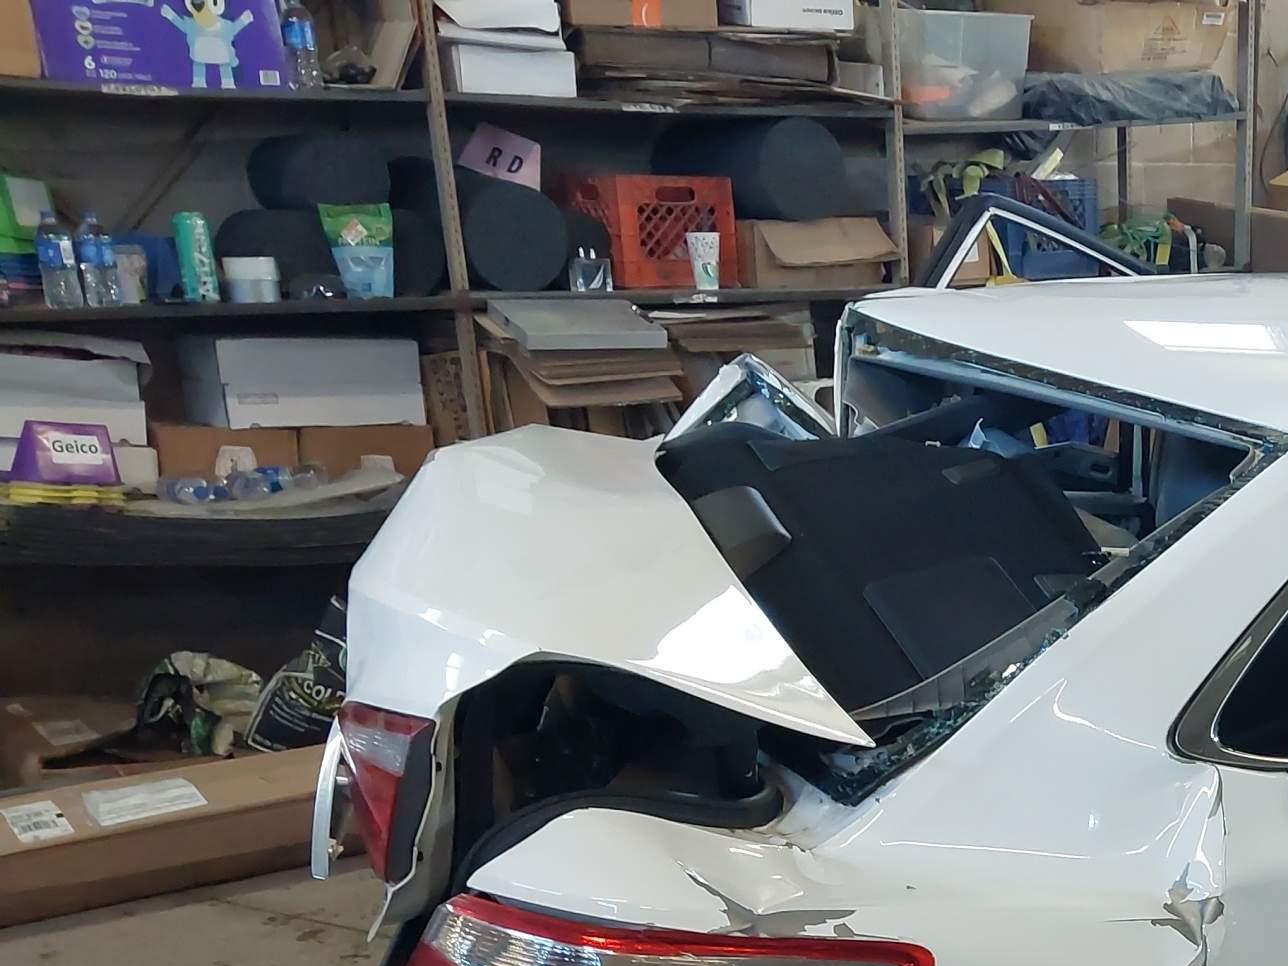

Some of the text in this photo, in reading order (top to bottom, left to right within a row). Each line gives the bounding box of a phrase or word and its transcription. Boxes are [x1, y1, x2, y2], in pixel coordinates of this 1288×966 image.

[84, 55, 96, 69] 6
[99, 68, 117, 80] 120
[486, 146, 524, 174] R D
[51, 439, 99, 455] Geico
